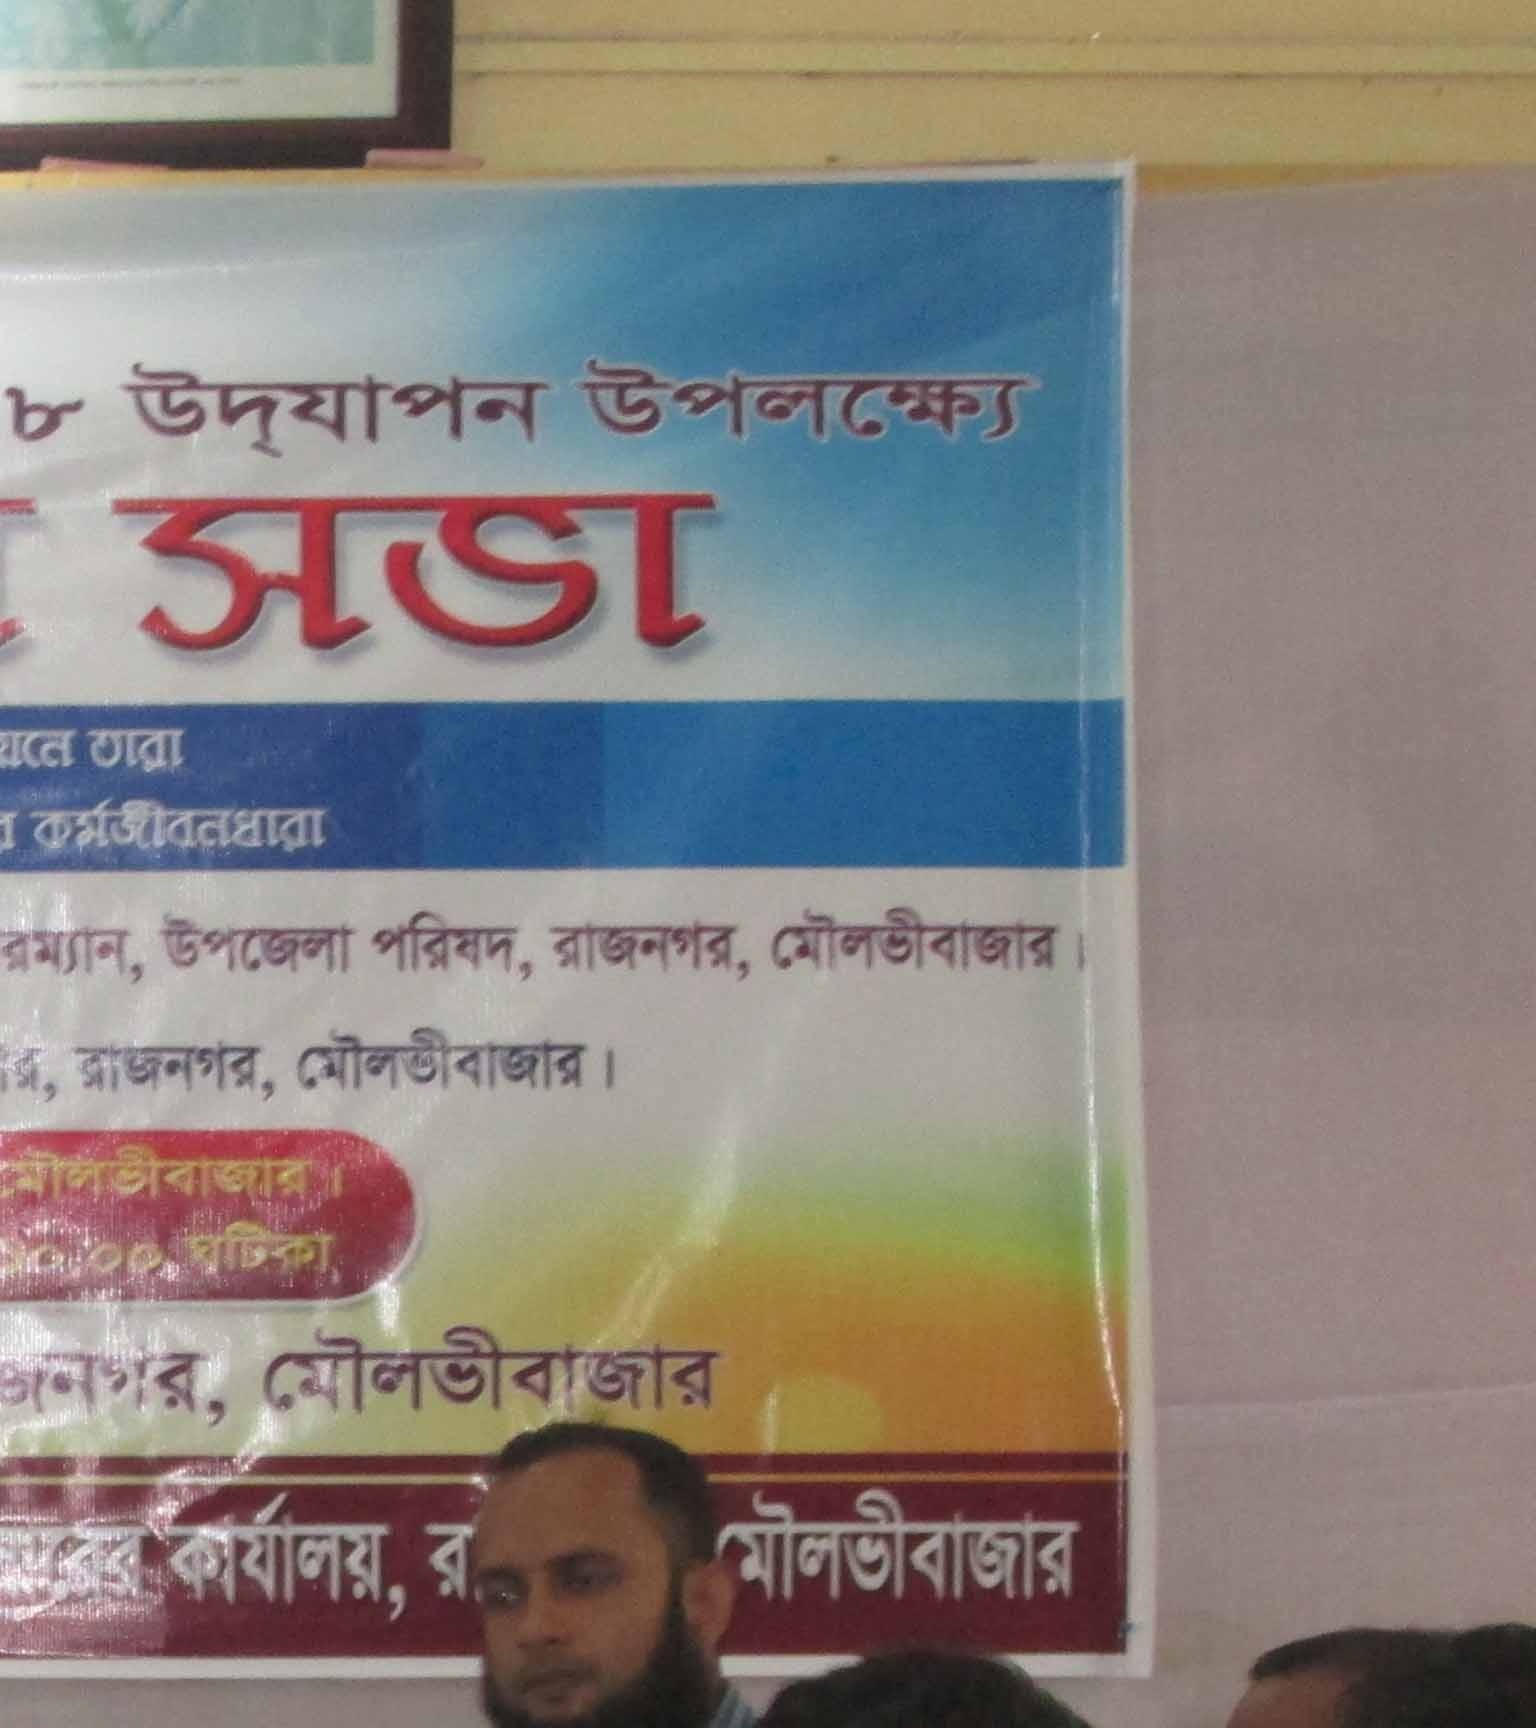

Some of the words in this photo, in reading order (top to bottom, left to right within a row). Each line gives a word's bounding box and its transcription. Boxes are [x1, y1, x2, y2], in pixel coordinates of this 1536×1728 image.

[578, 356, 1039, 444] উপলক্ষ্যে
[112, 493, 716, 651] সভা
[86, 727, 185, 773] তারা
[158, 911, 357, 976] উপজেলা
[372, 910, 533, 981] পরিষদ,
[550, 920, 751, 981] রাজনগর,
[262, 1324, 722, 1415] মৌলভীবাজার
[716, 1488, 1081, 1600] মৌলভীবাজার
